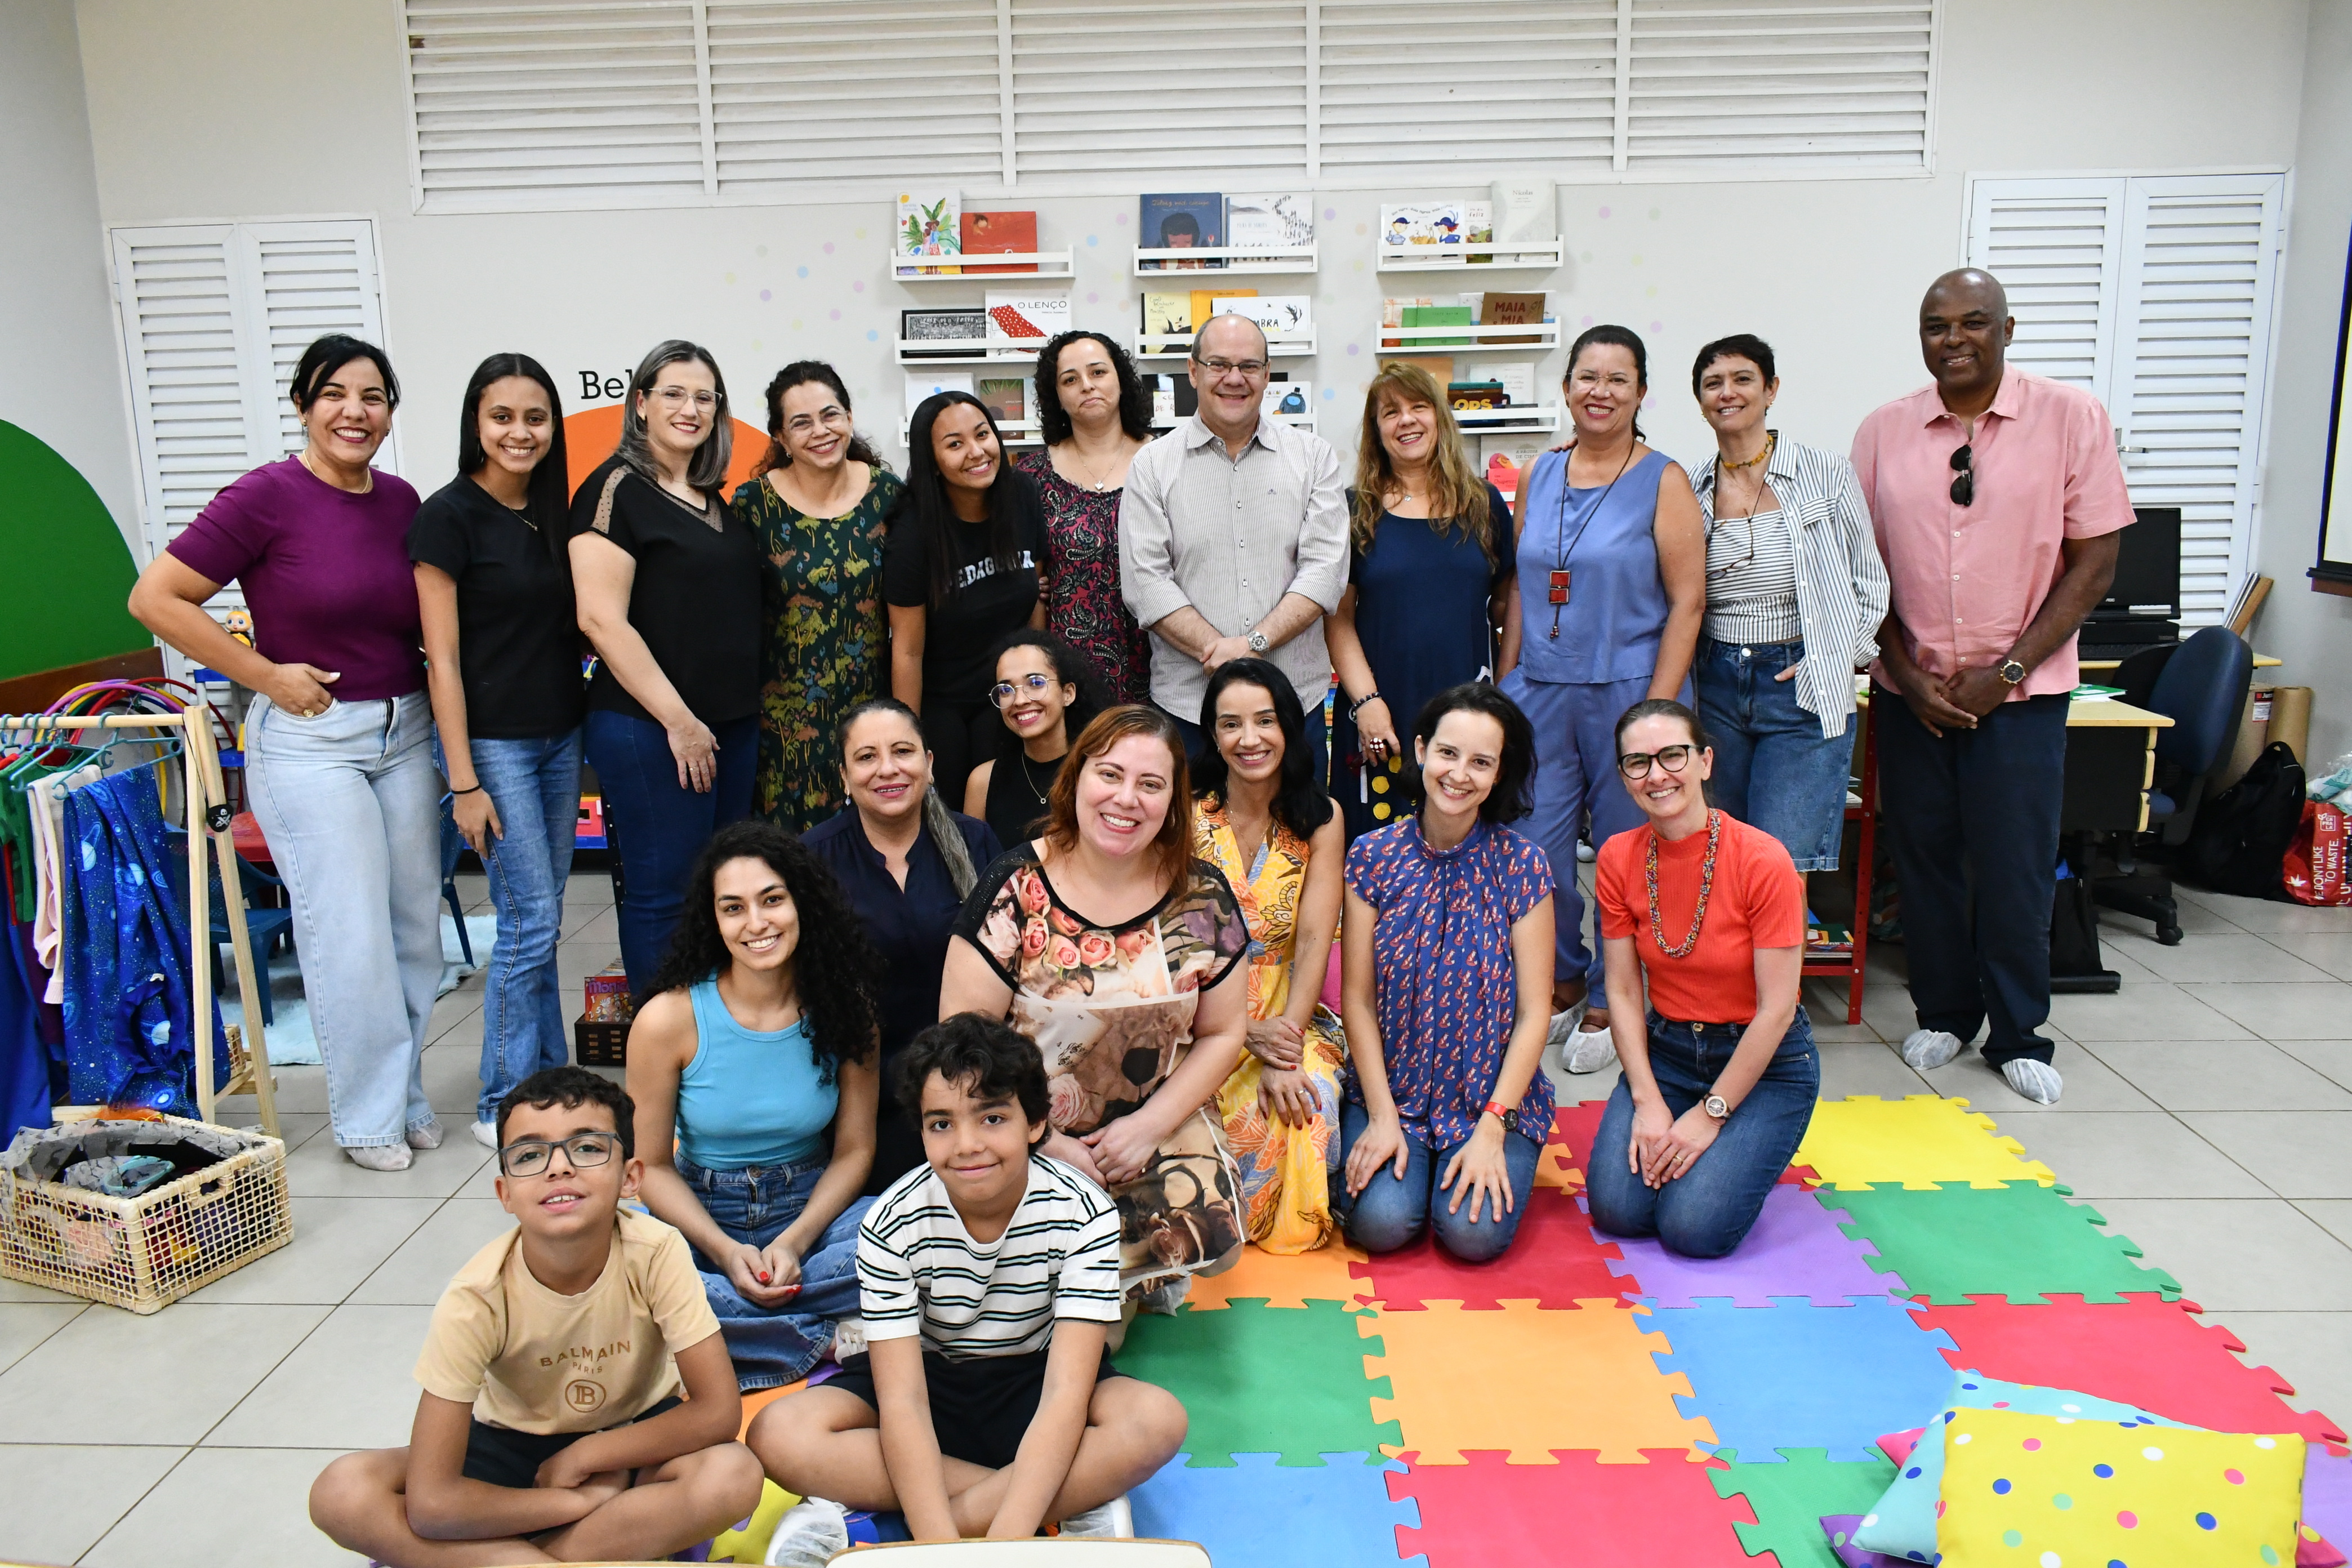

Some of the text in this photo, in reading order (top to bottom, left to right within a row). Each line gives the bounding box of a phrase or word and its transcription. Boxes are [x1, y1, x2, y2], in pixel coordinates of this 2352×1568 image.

[1028, 301, 1067, 310] LENÇO
[1495, 302, 1525, 312] MAIA
[1501, 315, 1524, 324] MIA
[2313, 846, 2323, 863] LIKE
[2325, 871, 2336, 882] TO
[2314, 890, 2324, 899] WE
[540, 1340, 630, 1367] BALMAIN
[573, 1362, 603, 1374] PARIS
